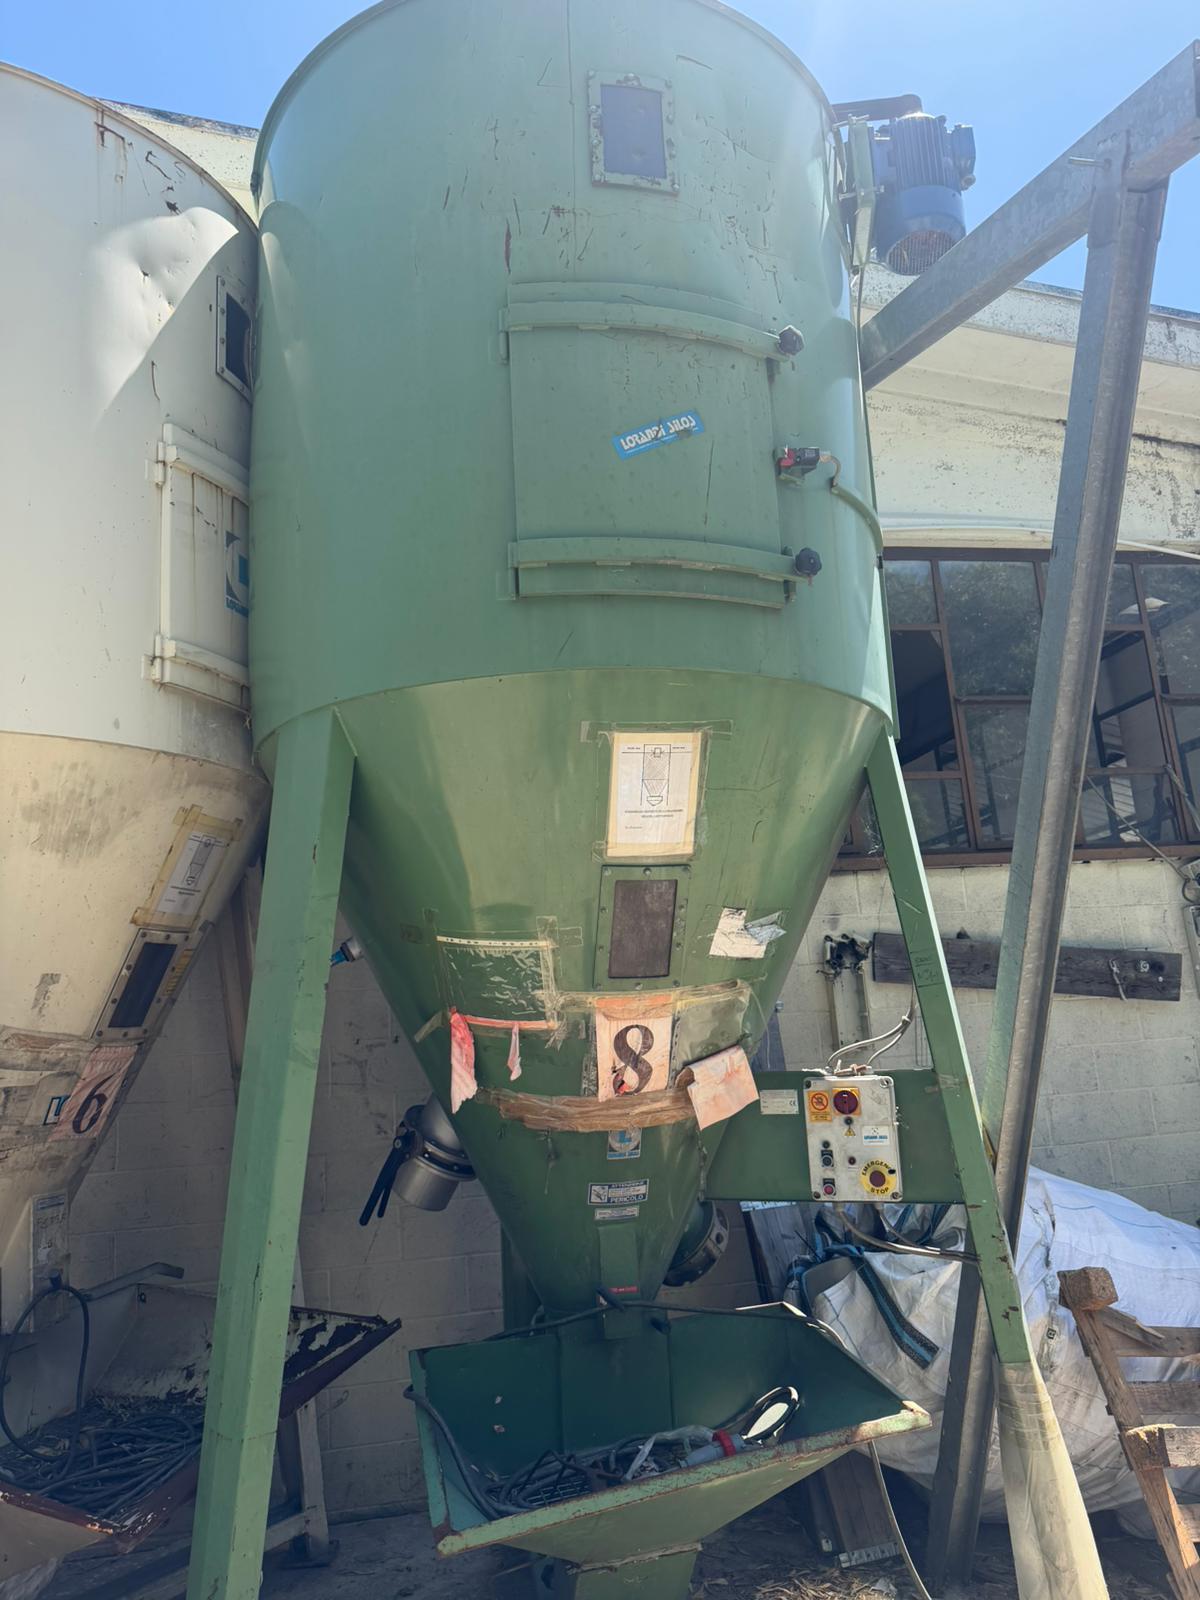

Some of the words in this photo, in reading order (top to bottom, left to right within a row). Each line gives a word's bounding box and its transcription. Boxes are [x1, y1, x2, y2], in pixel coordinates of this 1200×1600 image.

[613, 1024, 654, 1096] 8
[72, 1071, 116, 1134] 6
[870, 1186, 889, 1194] STOP
